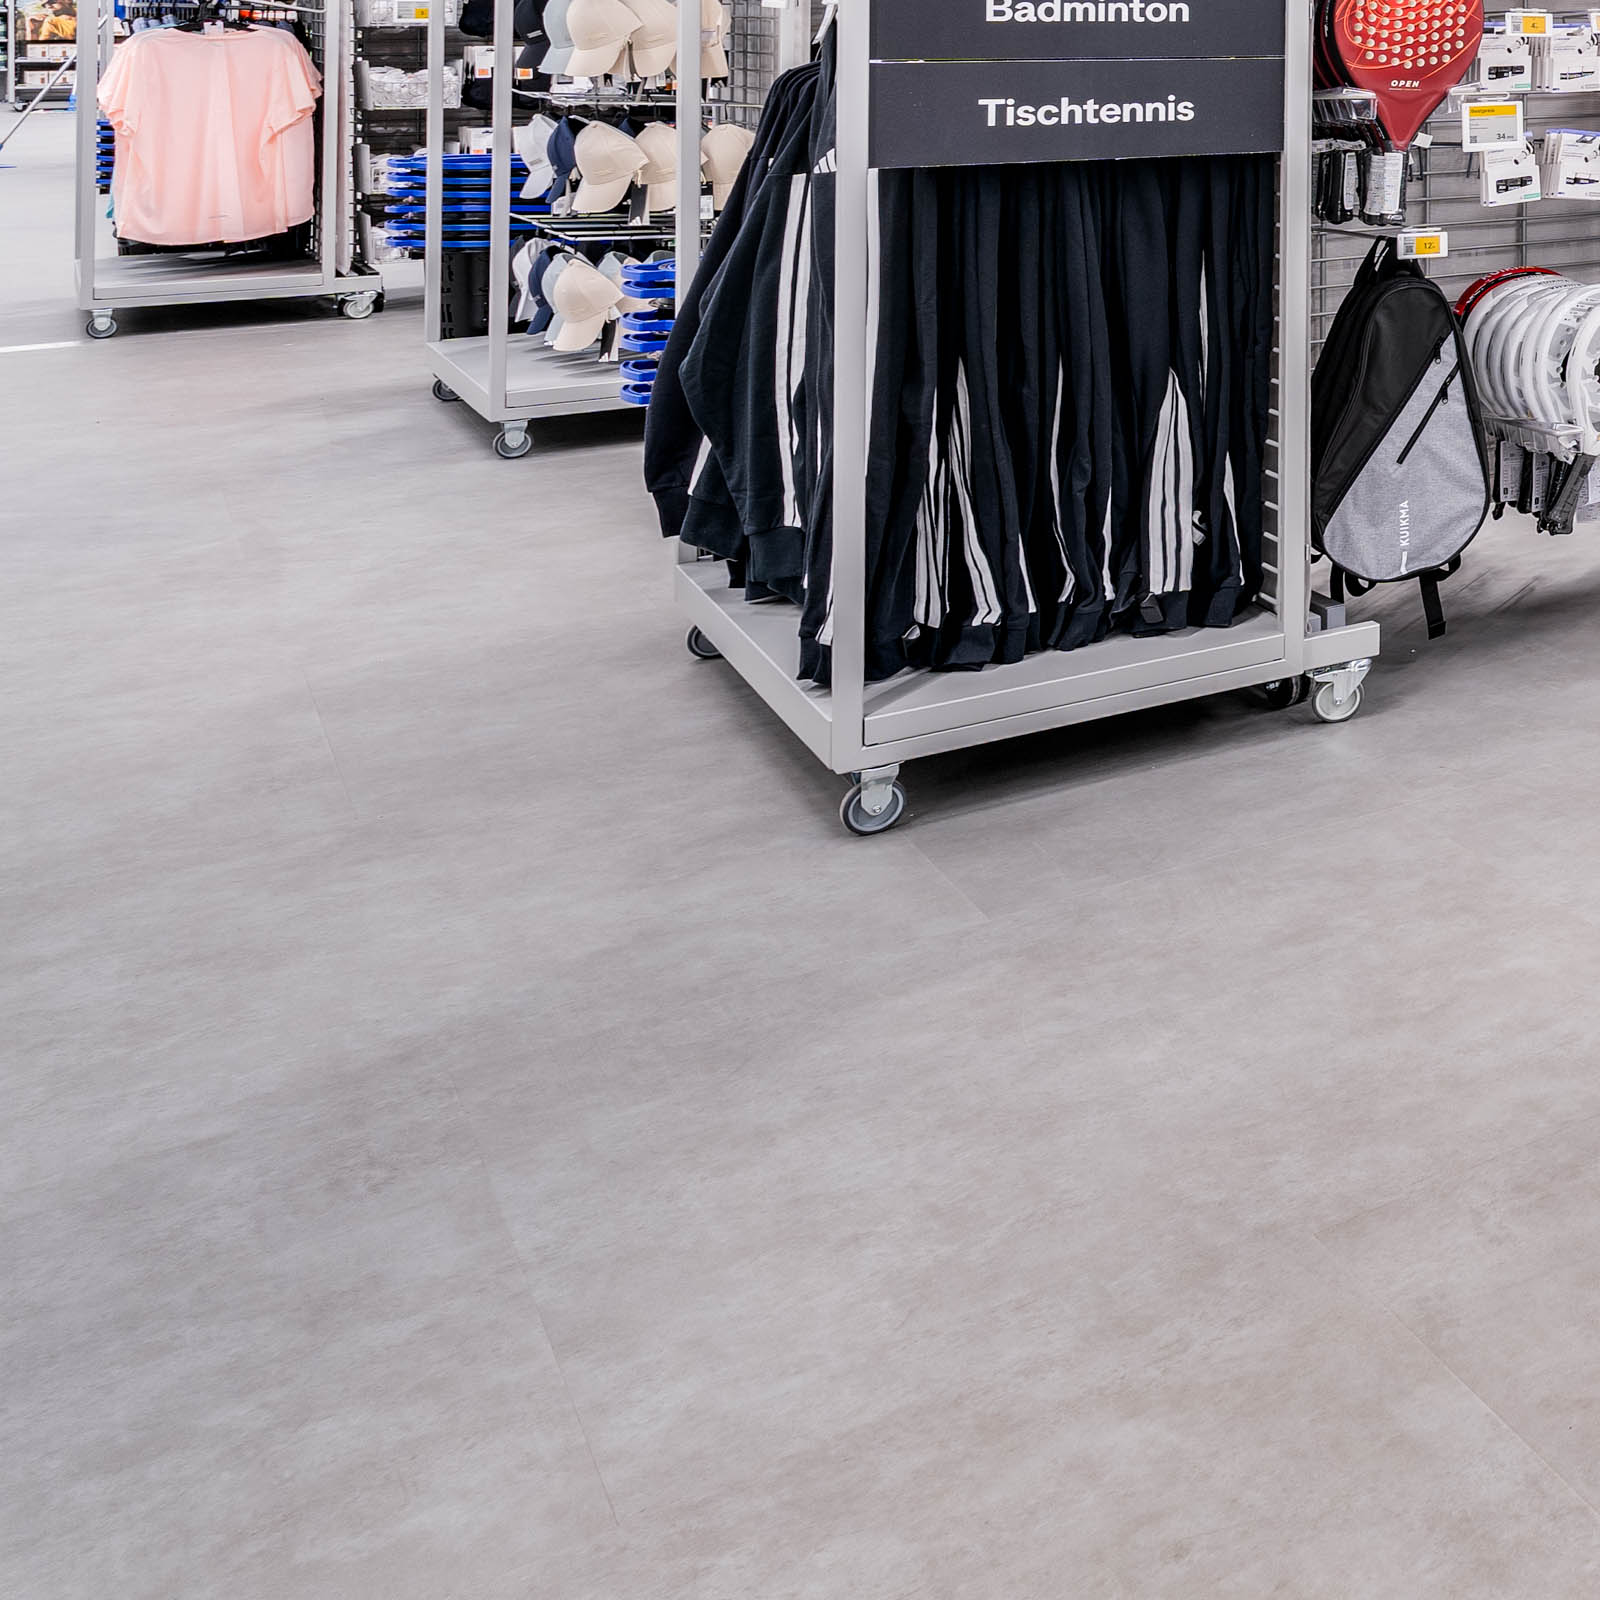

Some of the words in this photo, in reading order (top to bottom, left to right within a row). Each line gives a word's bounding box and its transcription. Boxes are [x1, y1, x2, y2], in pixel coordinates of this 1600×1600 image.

[1391, 80, 1420, 88] OPEN
[978, 95, 1194, 126] Tischtennis
[1400, 500, 1409, 546] KUIKMA
